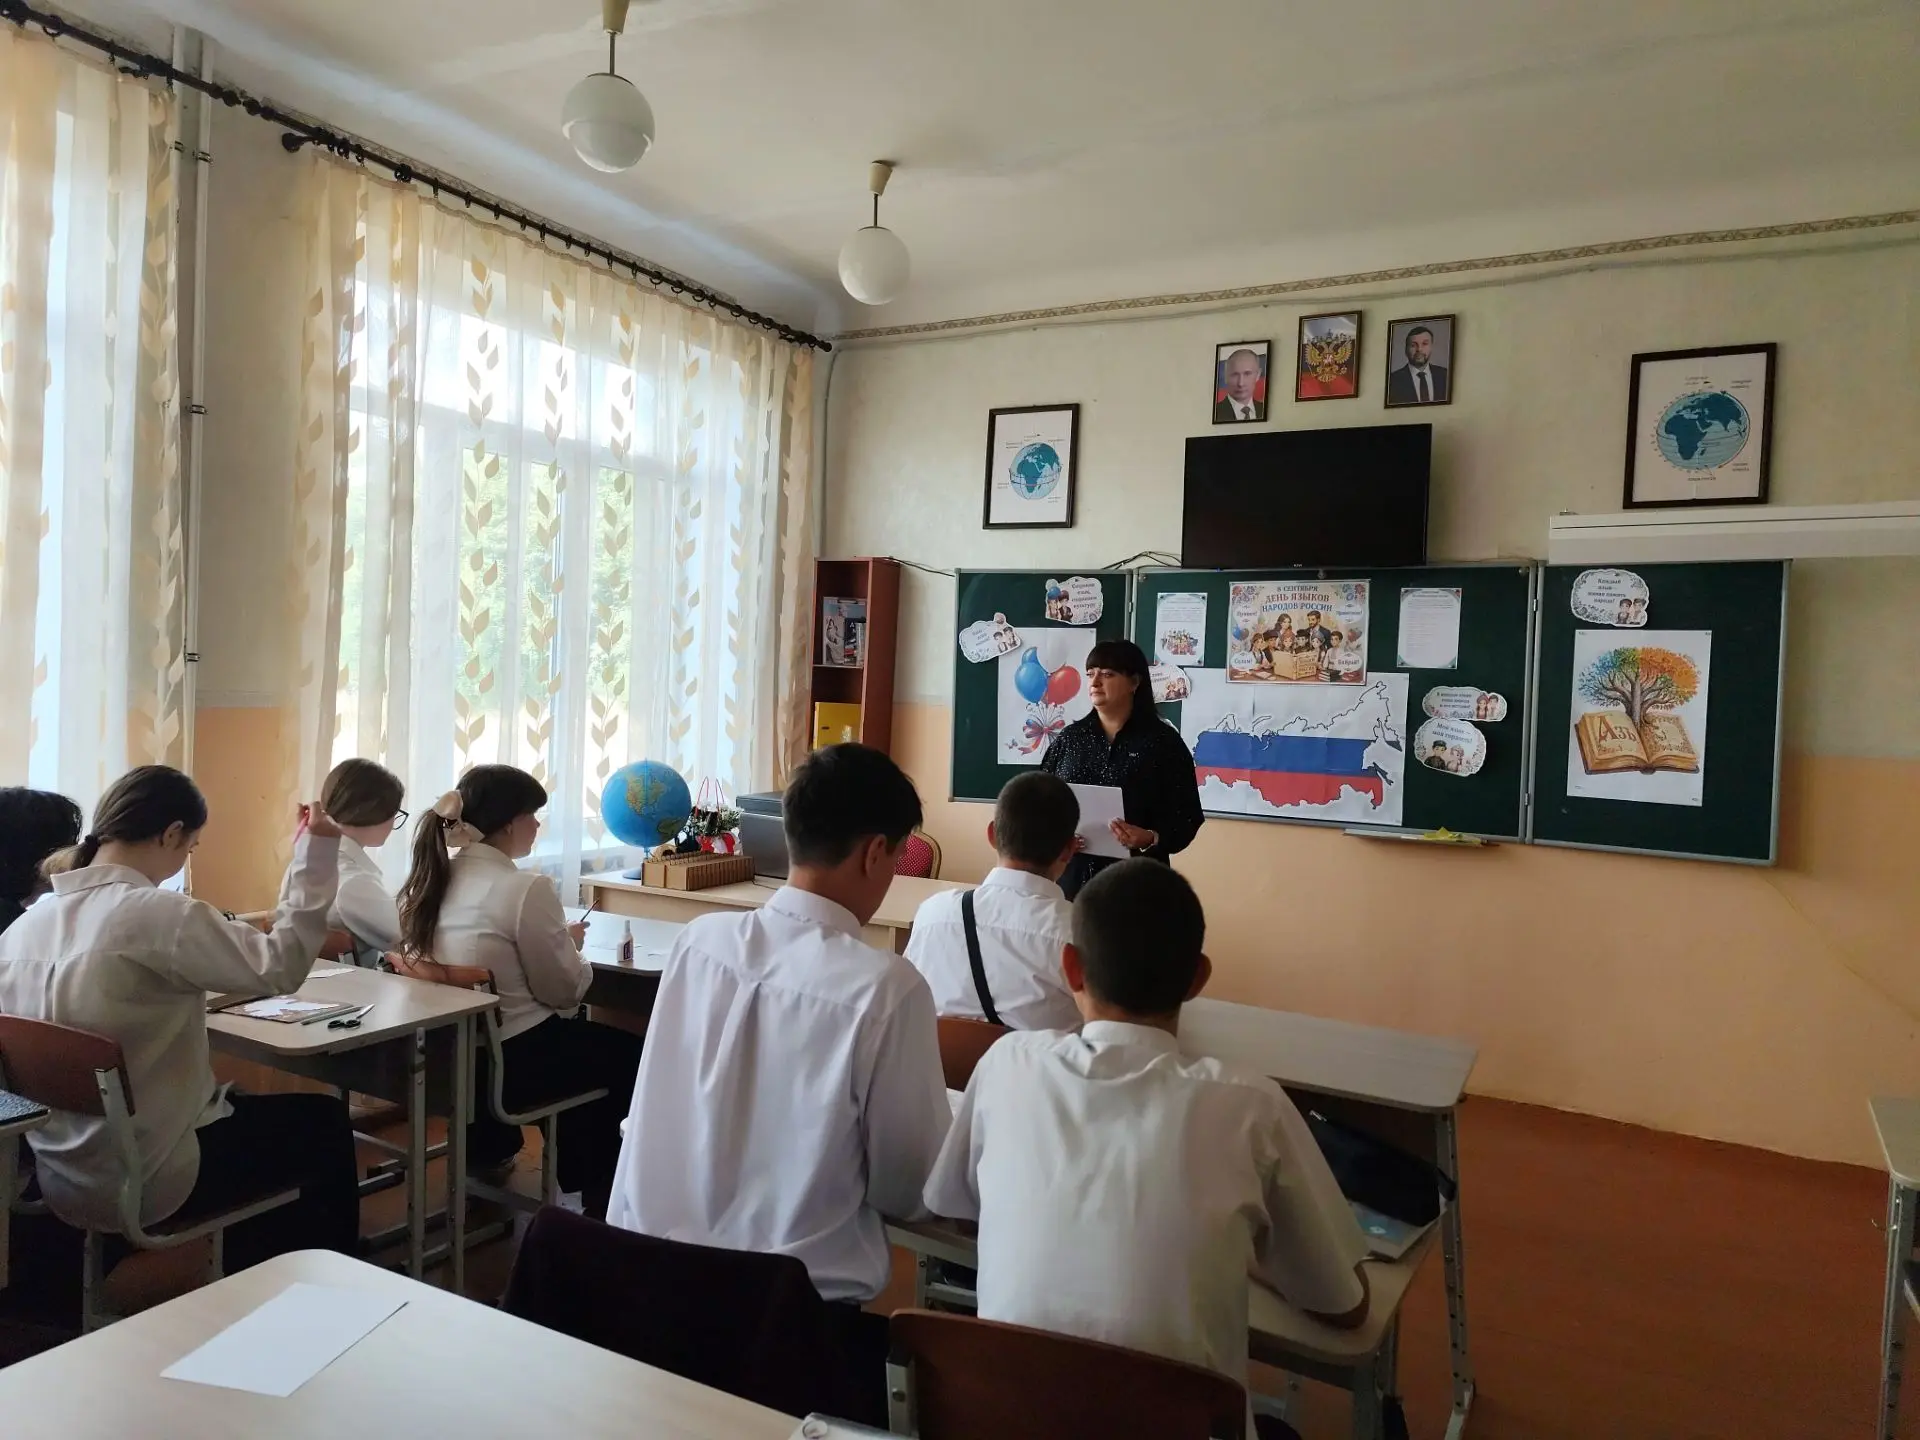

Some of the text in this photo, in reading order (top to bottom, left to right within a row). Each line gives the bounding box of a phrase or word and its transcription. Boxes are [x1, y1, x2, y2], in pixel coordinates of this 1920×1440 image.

[1265, 593, 1330, 604] ДЕНЬ ЯЗЫКОВ
[1262, 602, 1333, 613] НАРОДОВ РОССИИ
[1444, 733, 1473, 744] гордость!
